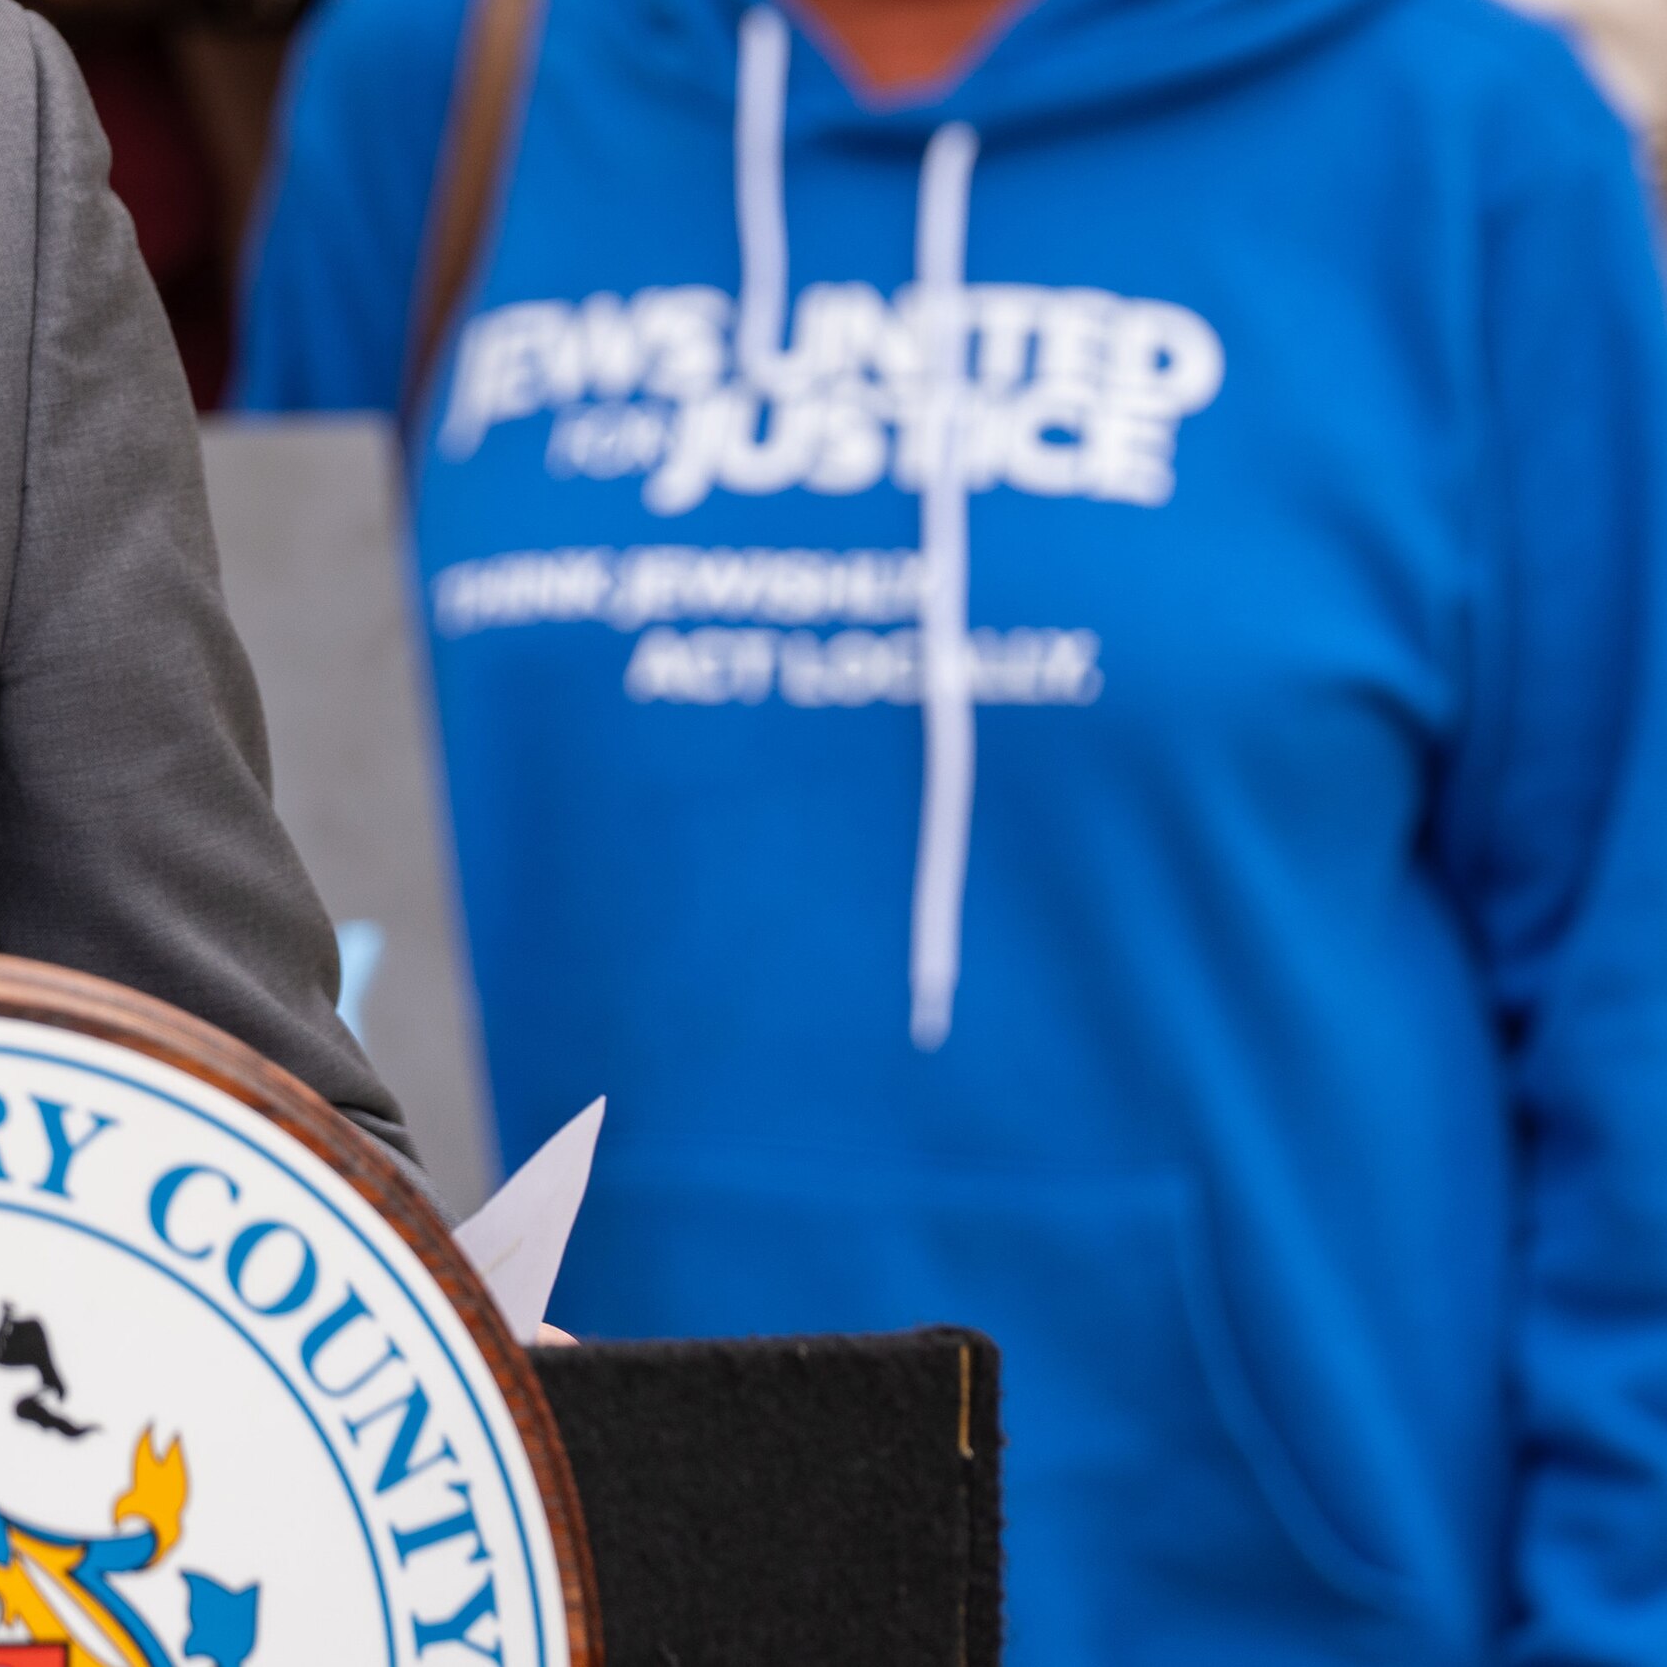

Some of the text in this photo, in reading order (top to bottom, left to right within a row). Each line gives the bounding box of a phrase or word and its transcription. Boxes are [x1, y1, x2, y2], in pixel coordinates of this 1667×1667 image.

[439, 284, 1223, 458] JEWS UNTED
[645, 384, 1175, 514] JUSTICE
[143, 1160, 507, 1667] COUNTY
